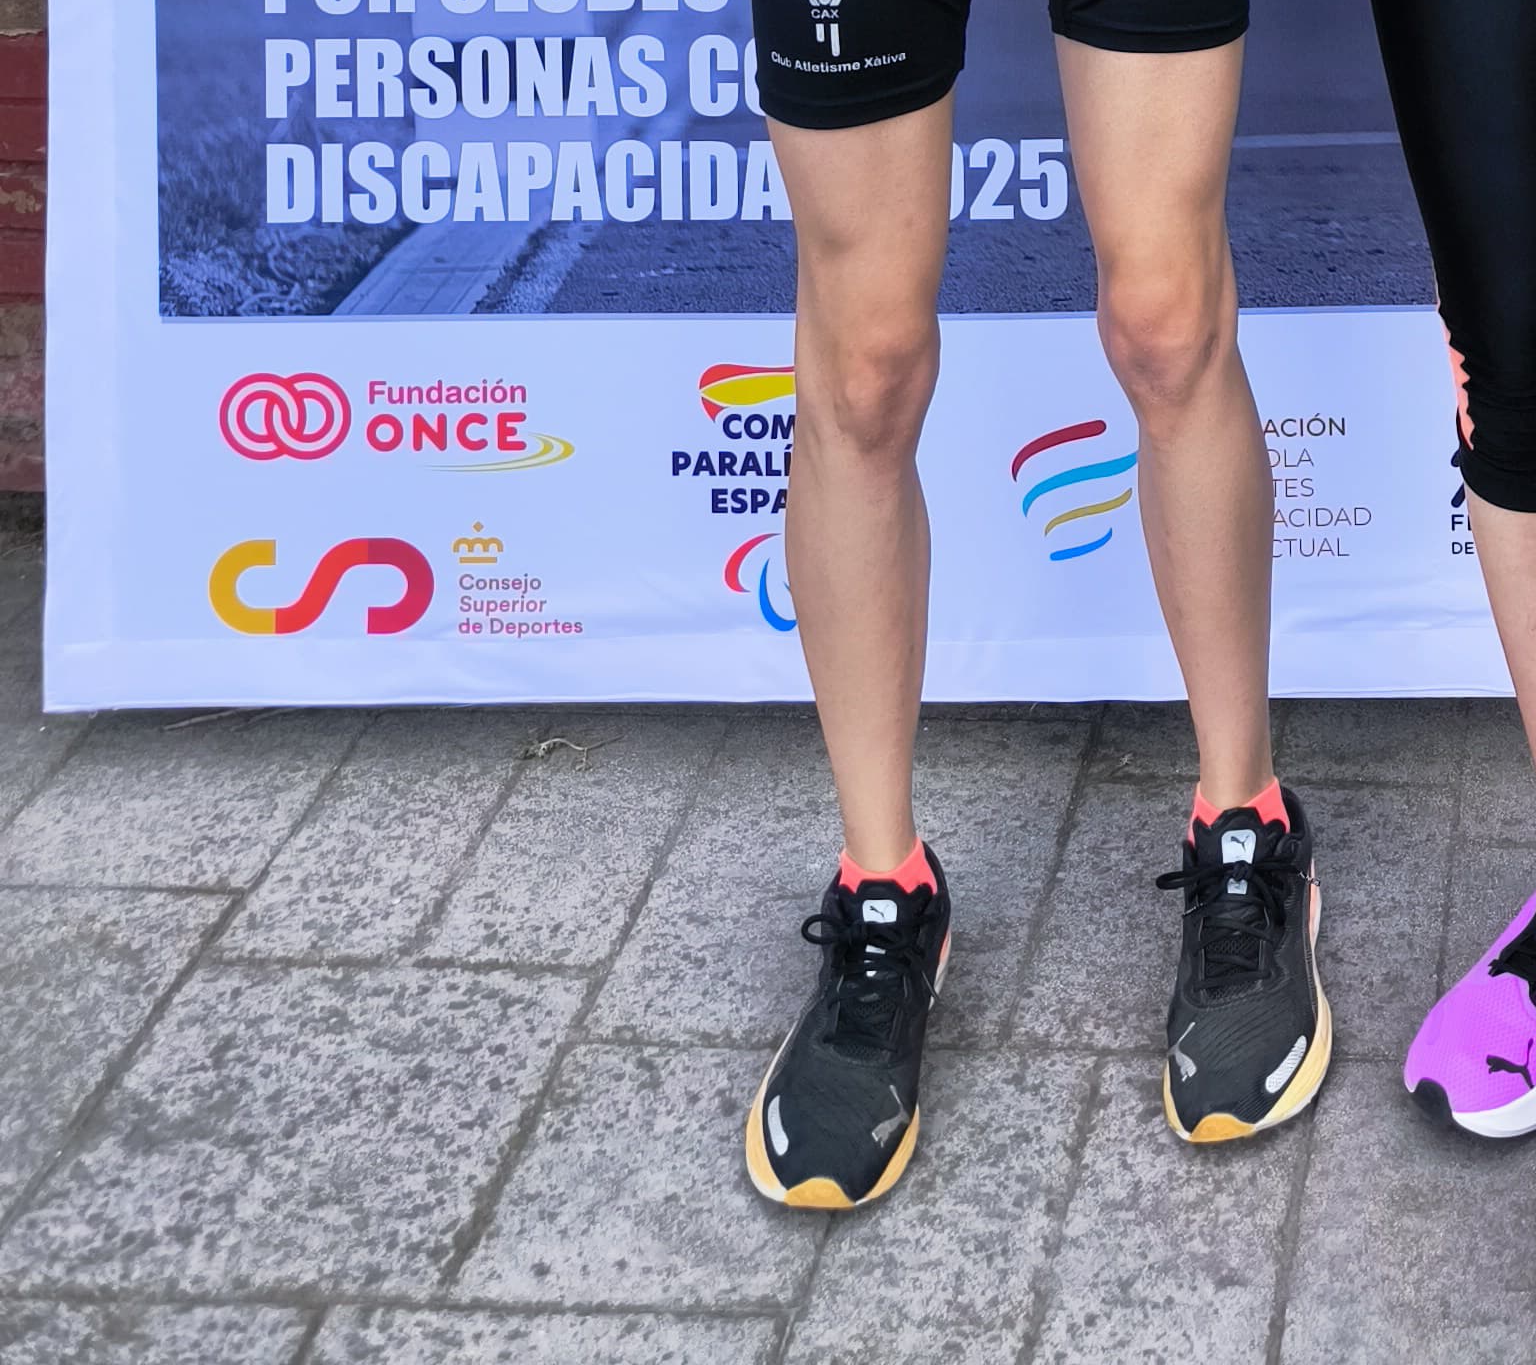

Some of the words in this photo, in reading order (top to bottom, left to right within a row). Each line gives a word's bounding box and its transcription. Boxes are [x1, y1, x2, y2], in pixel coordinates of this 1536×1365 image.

[811, 9, 839, 19] CAX
[771, 51, 792, 68] Club
[794, 60, 861, 73] Atletisme
[864, 52, 906, 68] Xàtiva
[264, 35, 669, 119] PERSONAS
[367, 378, 527, 405] Fundación
[366, 412, 527, 452] ONCE
[1263, 413, 1346, 437] ACIÓN
[672, 444, 793, 476] PARALÍ
[1452, 542, 1474, 554] DE
[459, 573, 541, 594] Consejo
[459, 595, 547, 616] Superior
[458, 618, 483, 634] de
[490, 618, 583, 638] Deportes
